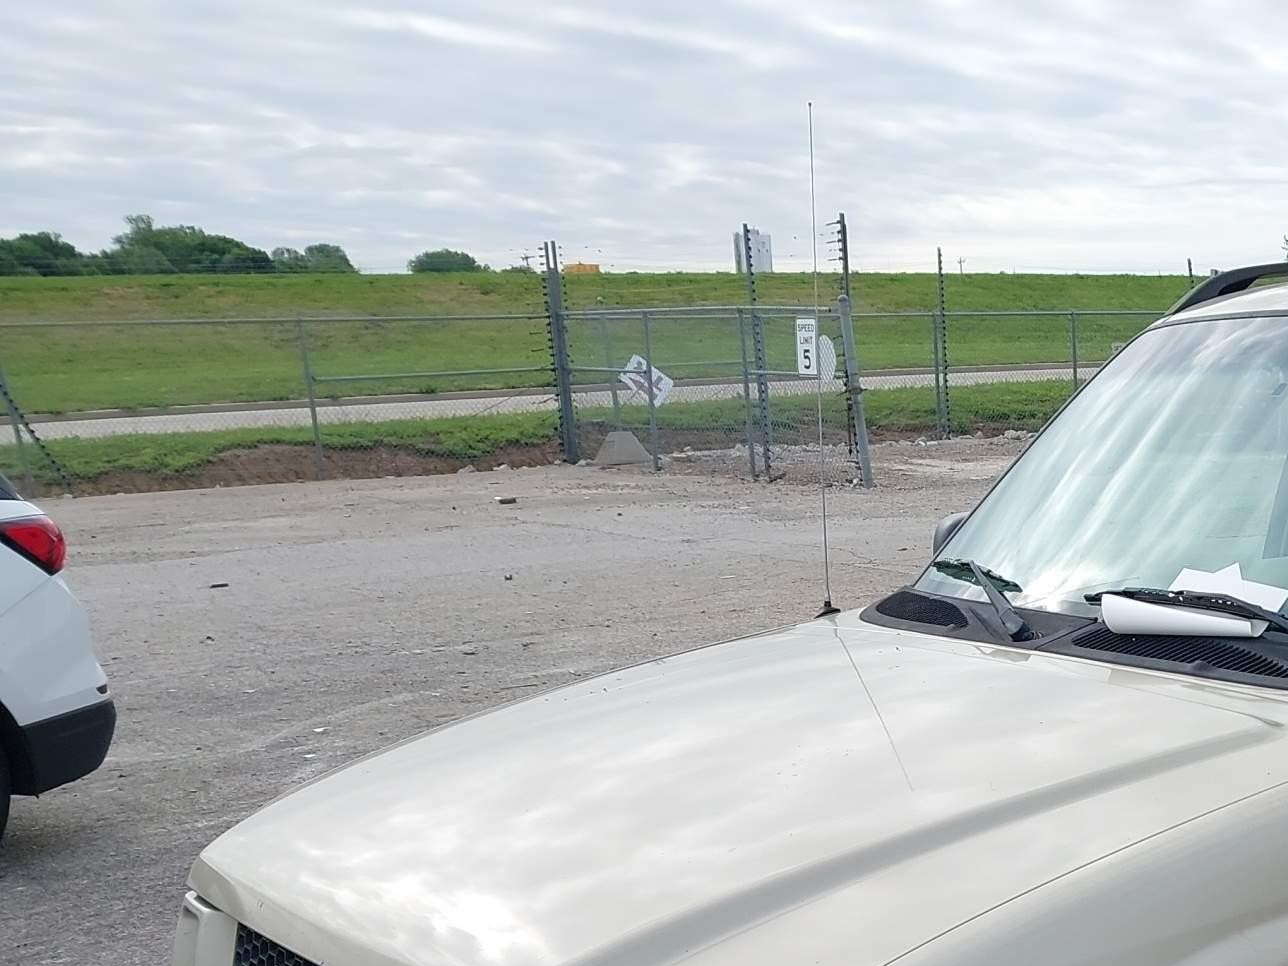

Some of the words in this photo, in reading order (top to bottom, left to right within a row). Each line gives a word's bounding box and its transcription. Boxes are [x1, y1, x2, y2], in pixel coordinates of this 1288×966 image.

[797, 323, 814, 333] SPEED
[800, 336, 813, 345] LIMIT
[803, 348, 812, 370] 5
